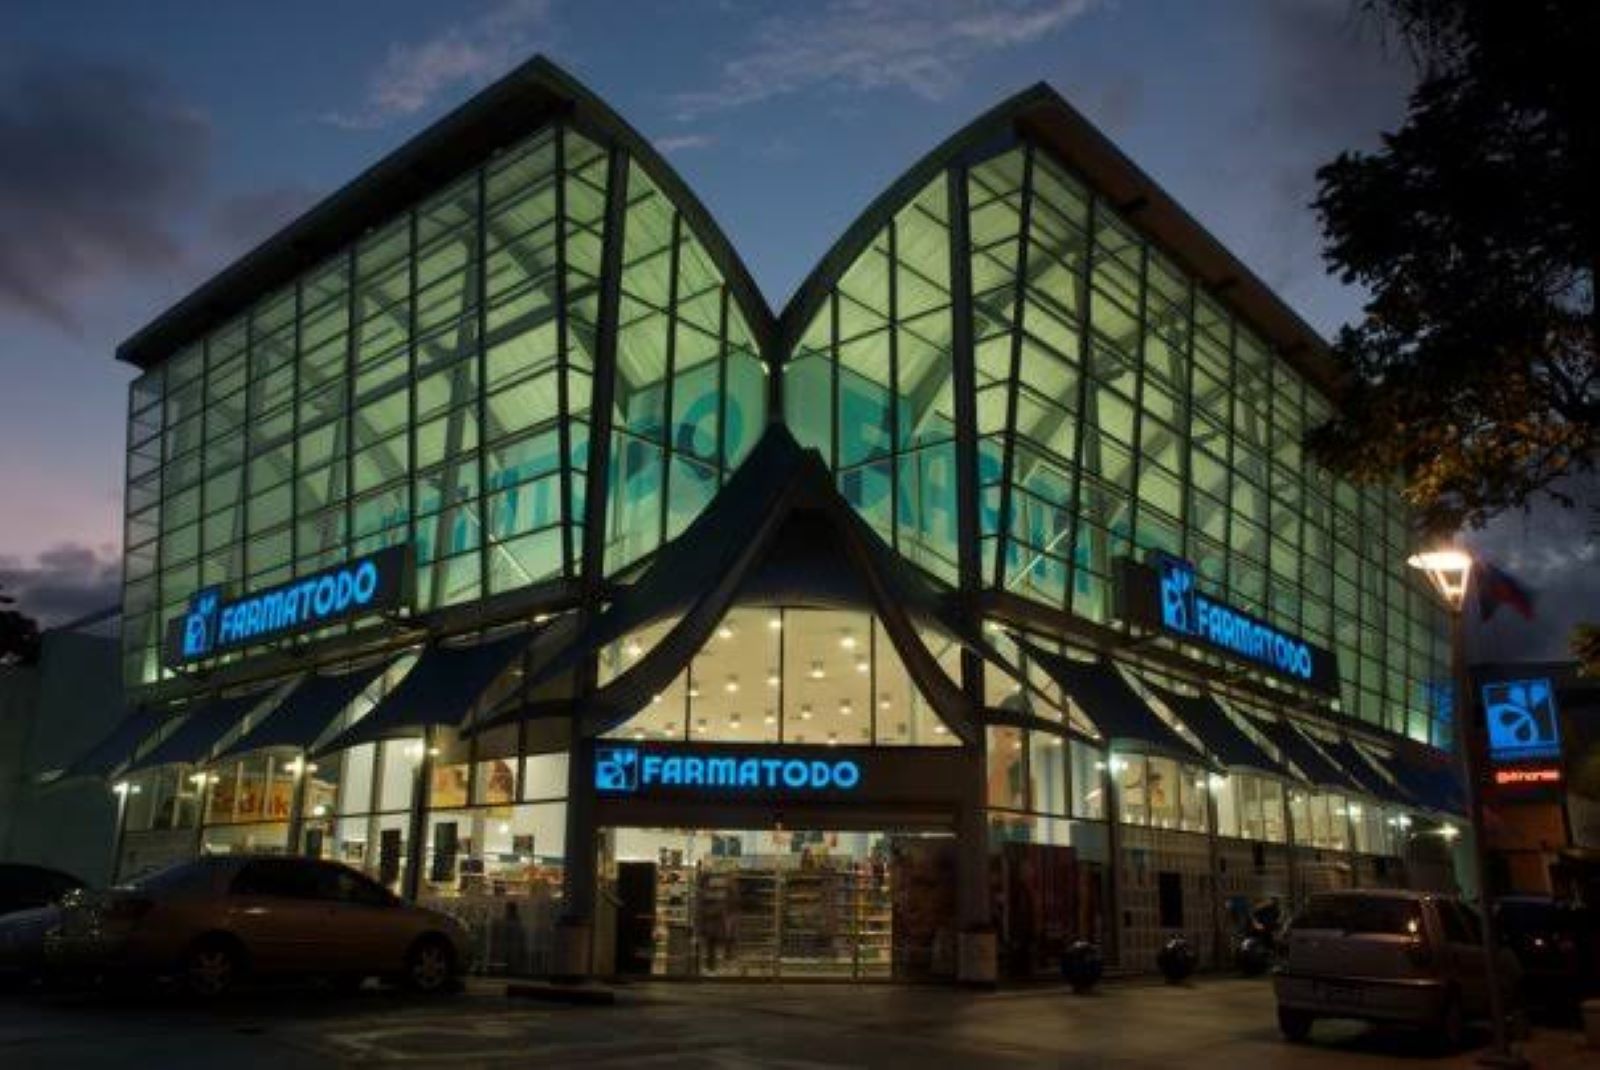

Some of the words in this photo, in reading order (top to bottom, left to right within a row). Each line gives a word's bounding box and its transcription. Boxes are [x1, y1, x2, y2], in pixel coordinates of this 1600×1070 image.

[218, 560, 378, 643] FARMATODO
[1197, 597, 1312, 678] FARMATODO
[641, 756, 859, 787] FARMATODO
